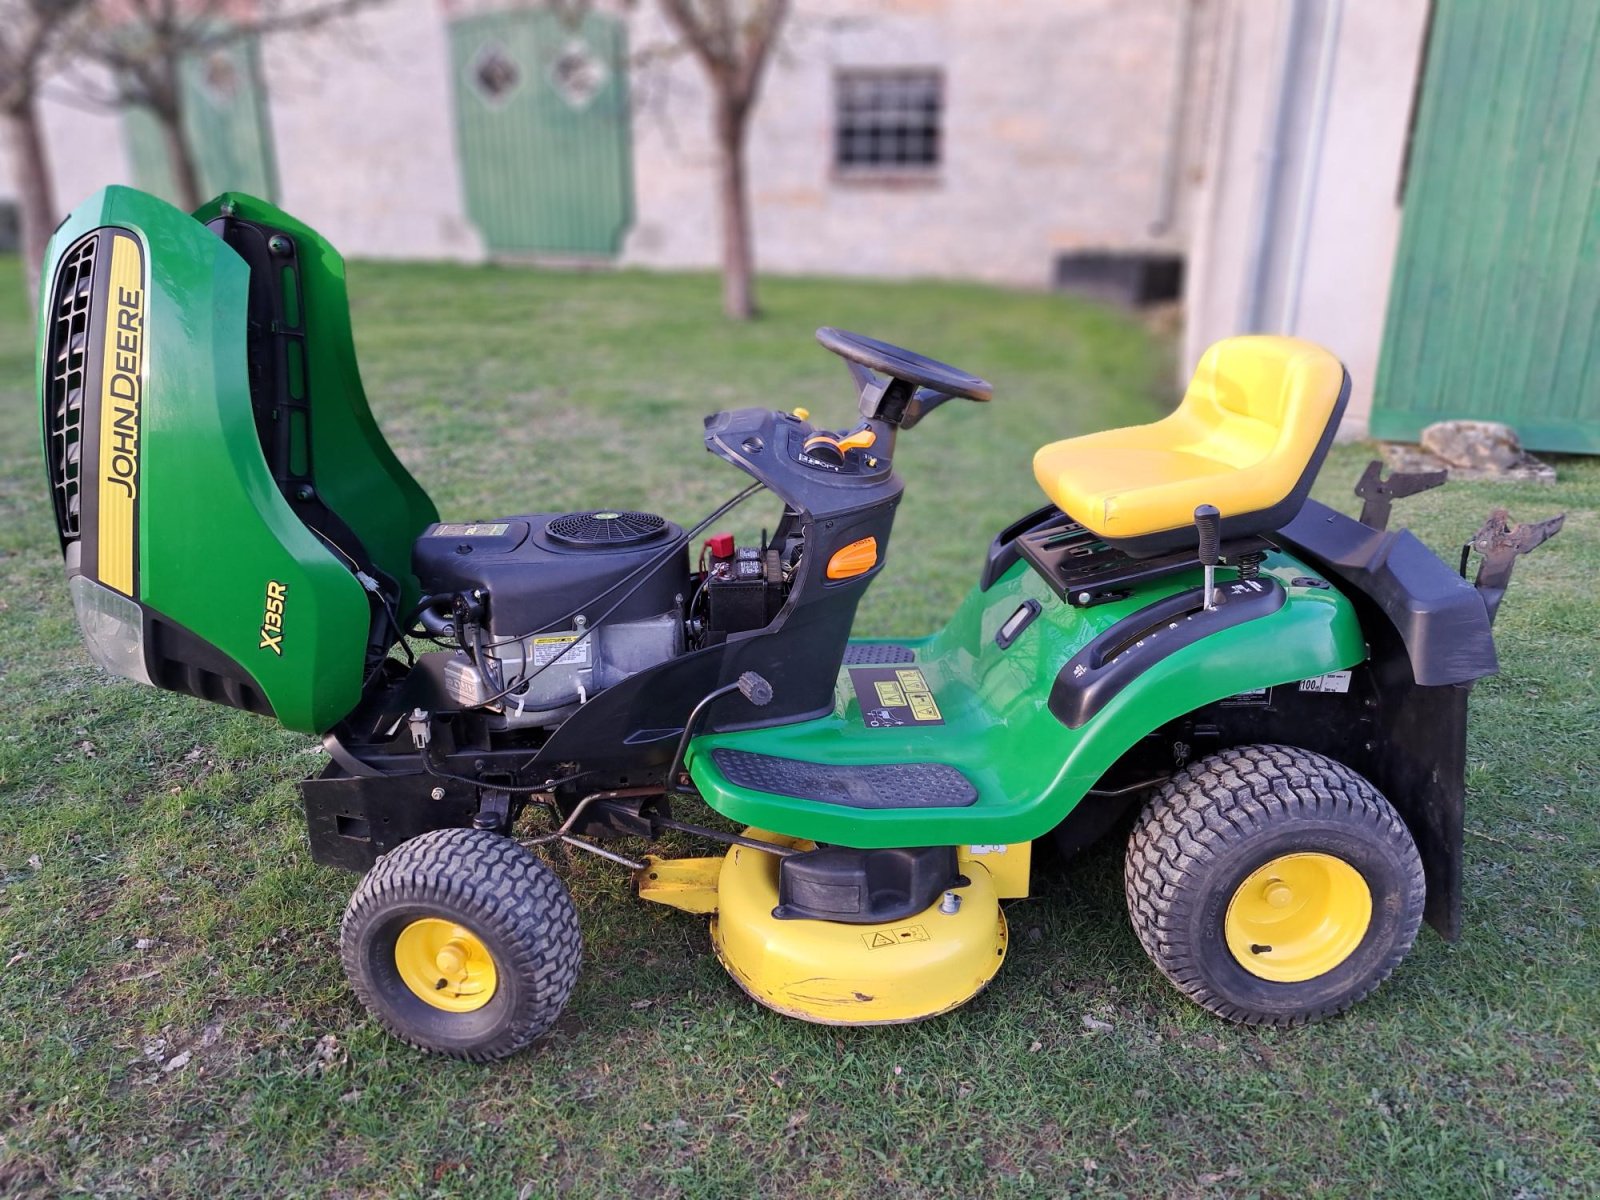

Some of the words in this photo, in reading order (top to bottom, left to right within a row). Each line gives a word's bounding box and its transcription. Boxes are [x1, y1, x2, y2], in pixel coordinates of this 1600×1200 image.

[110, 286, 140, 402] DEERE
[107, 406, 136, 499] JOHN
[260, 580, 287, 655] X135R
[1300, 679, 1317, 690] 100
